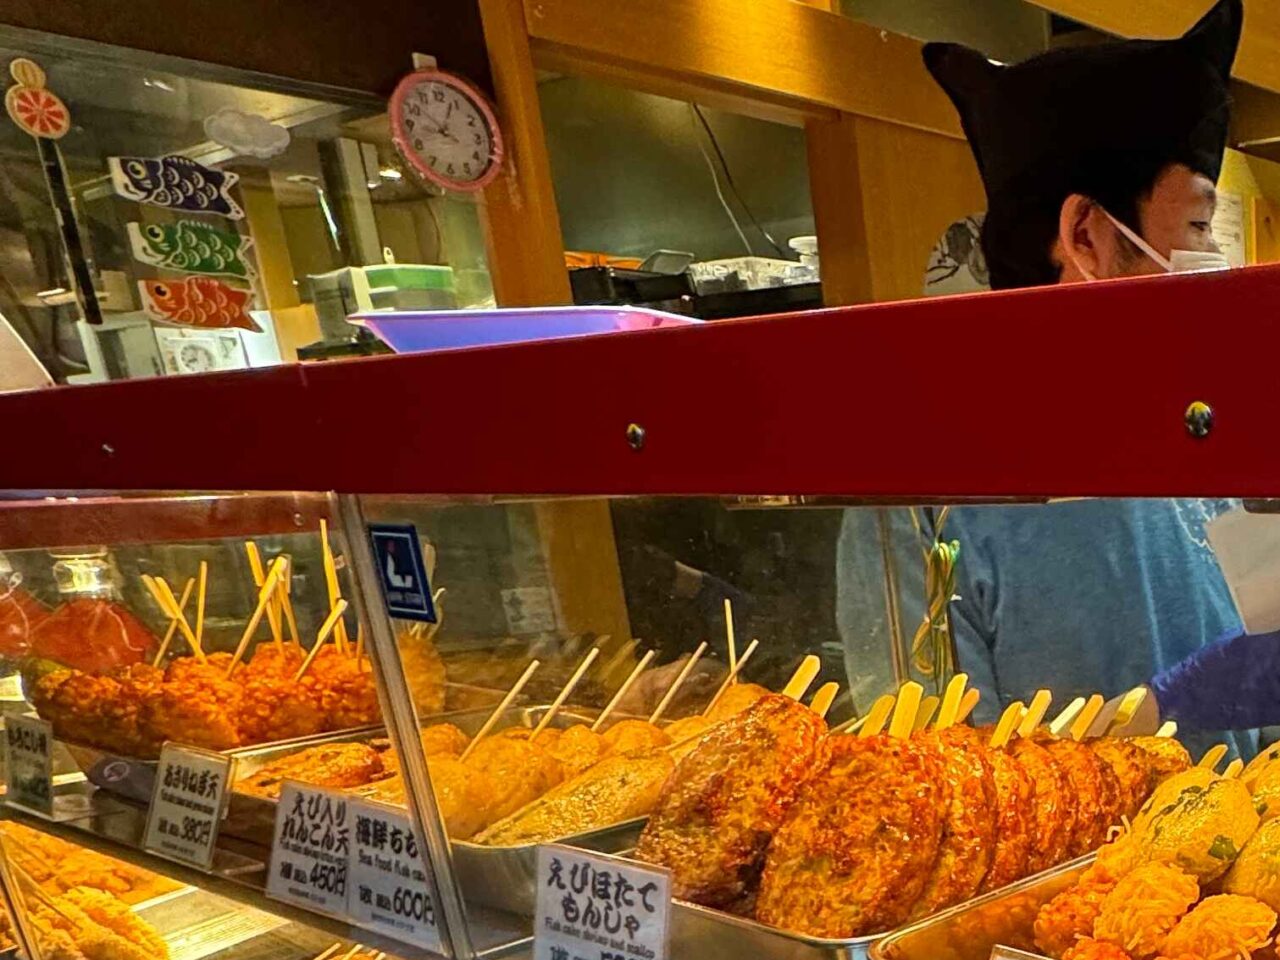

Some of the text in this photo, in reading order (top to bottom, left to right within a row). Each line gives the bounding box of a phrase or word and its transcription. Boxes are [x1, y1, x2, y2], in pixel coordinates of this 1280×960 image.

[292, 792, 346, 827] えび入り
[280, 814, 349, 855] れんこん天
[310, 862, 347, 897] 450円
[547, 857, 658, 913] えびほたて
[561, 891, 640, 939] もんじゃ
